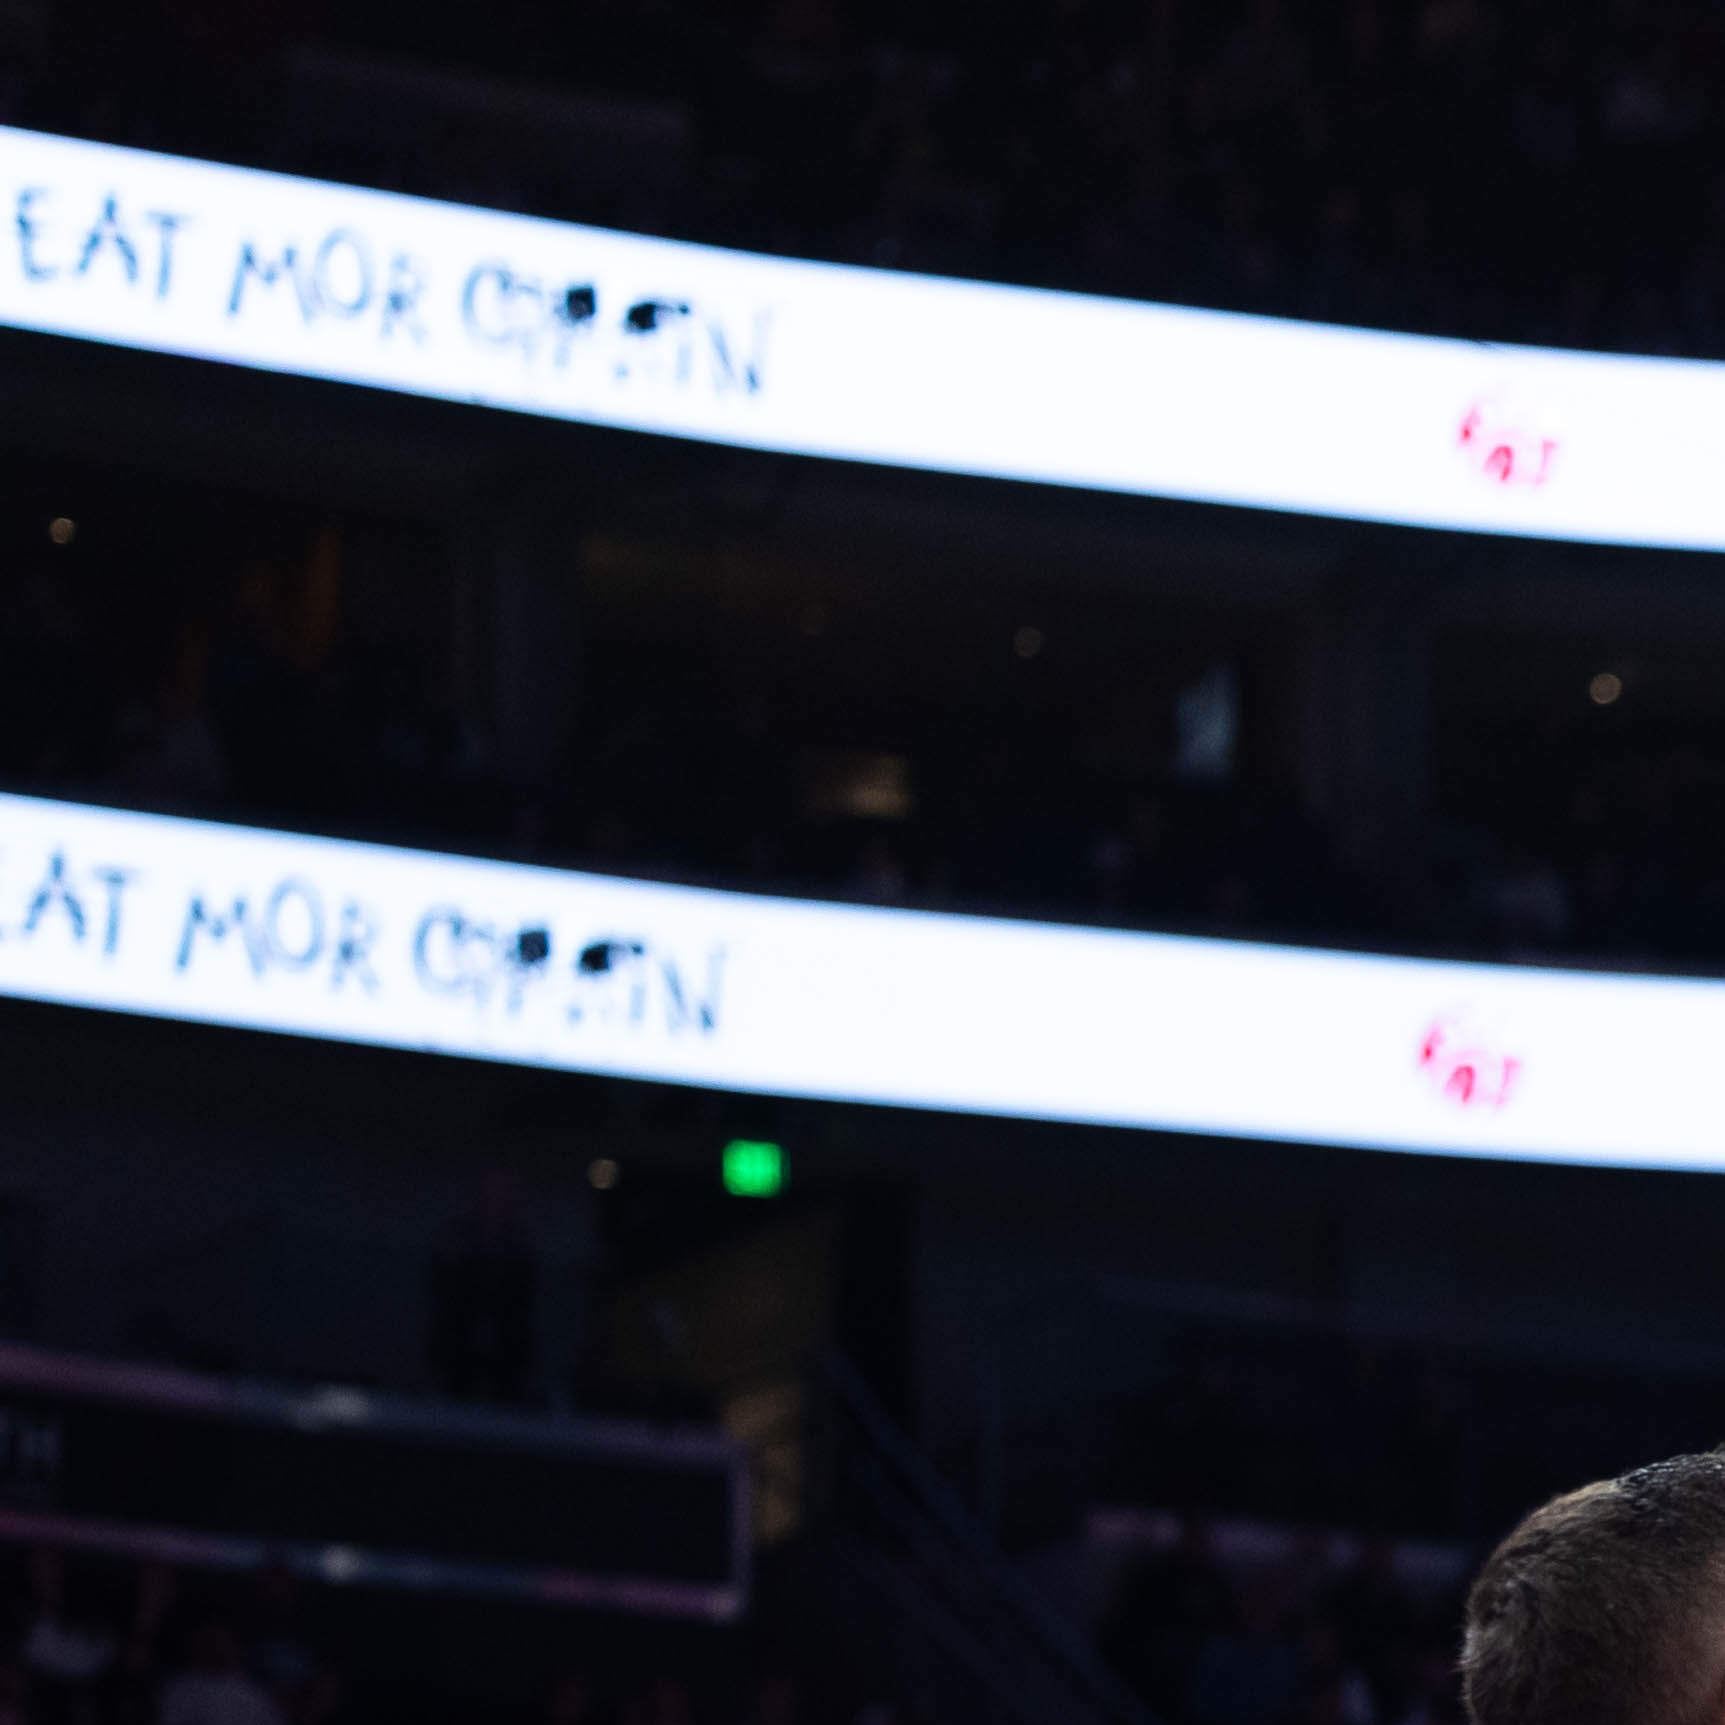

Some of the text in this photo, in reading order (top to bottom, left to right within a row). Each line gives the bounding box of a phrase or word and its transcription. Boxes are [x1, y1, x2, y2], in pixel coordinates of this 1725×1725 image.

[12, 182, 195, 303] EAT
[222, 224, 428, 350] MOR
[0, 843, 145, 962] AT
[172, 872, 384, 997] MOR
